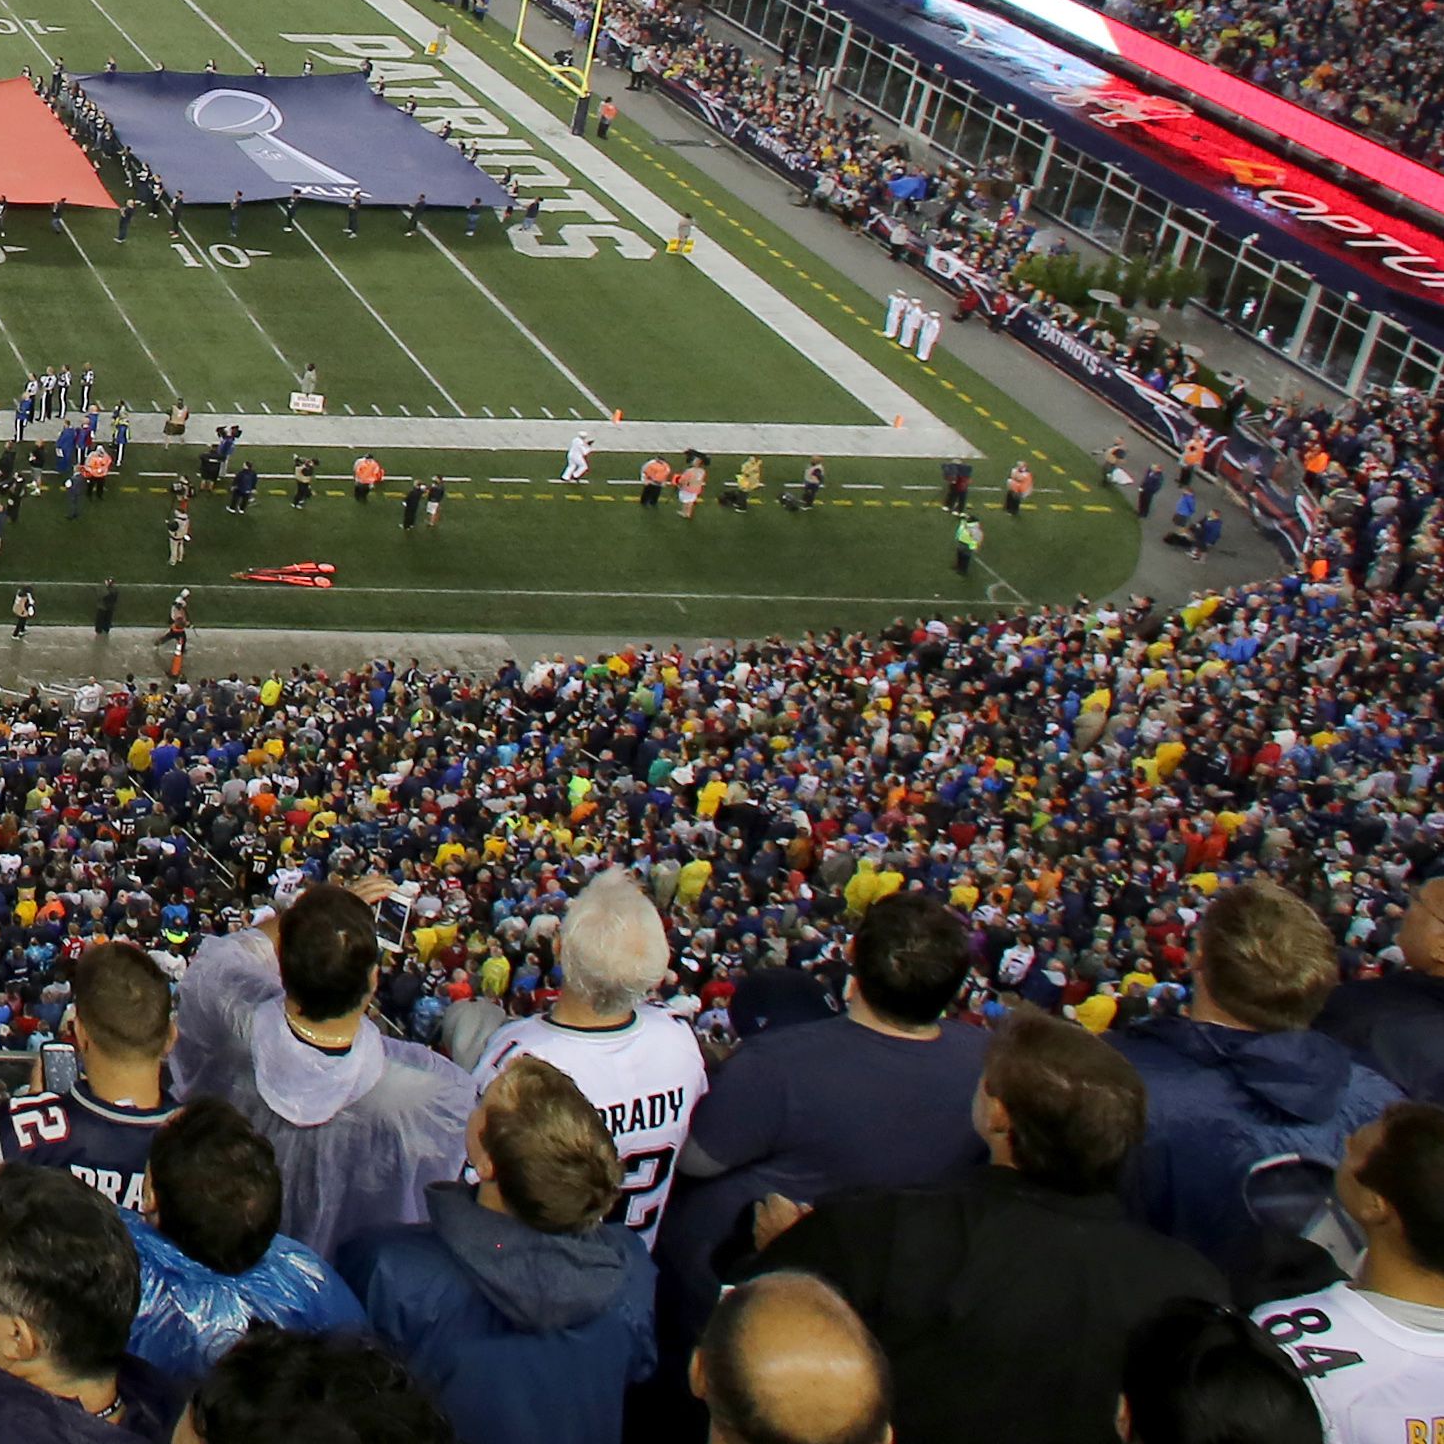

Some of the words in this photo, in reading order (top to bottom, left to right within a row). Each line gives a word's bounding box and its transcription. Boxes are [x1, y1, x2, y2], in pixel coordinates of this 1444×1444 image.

[170, 243, 253, 269] 10
[1037, 319, 1101, 376] PATRIOTS
[252, 860, 266, 874] 10
[10, 1091, 71, 1150] 12
[1261, 1307, 1366, 1379] 84
